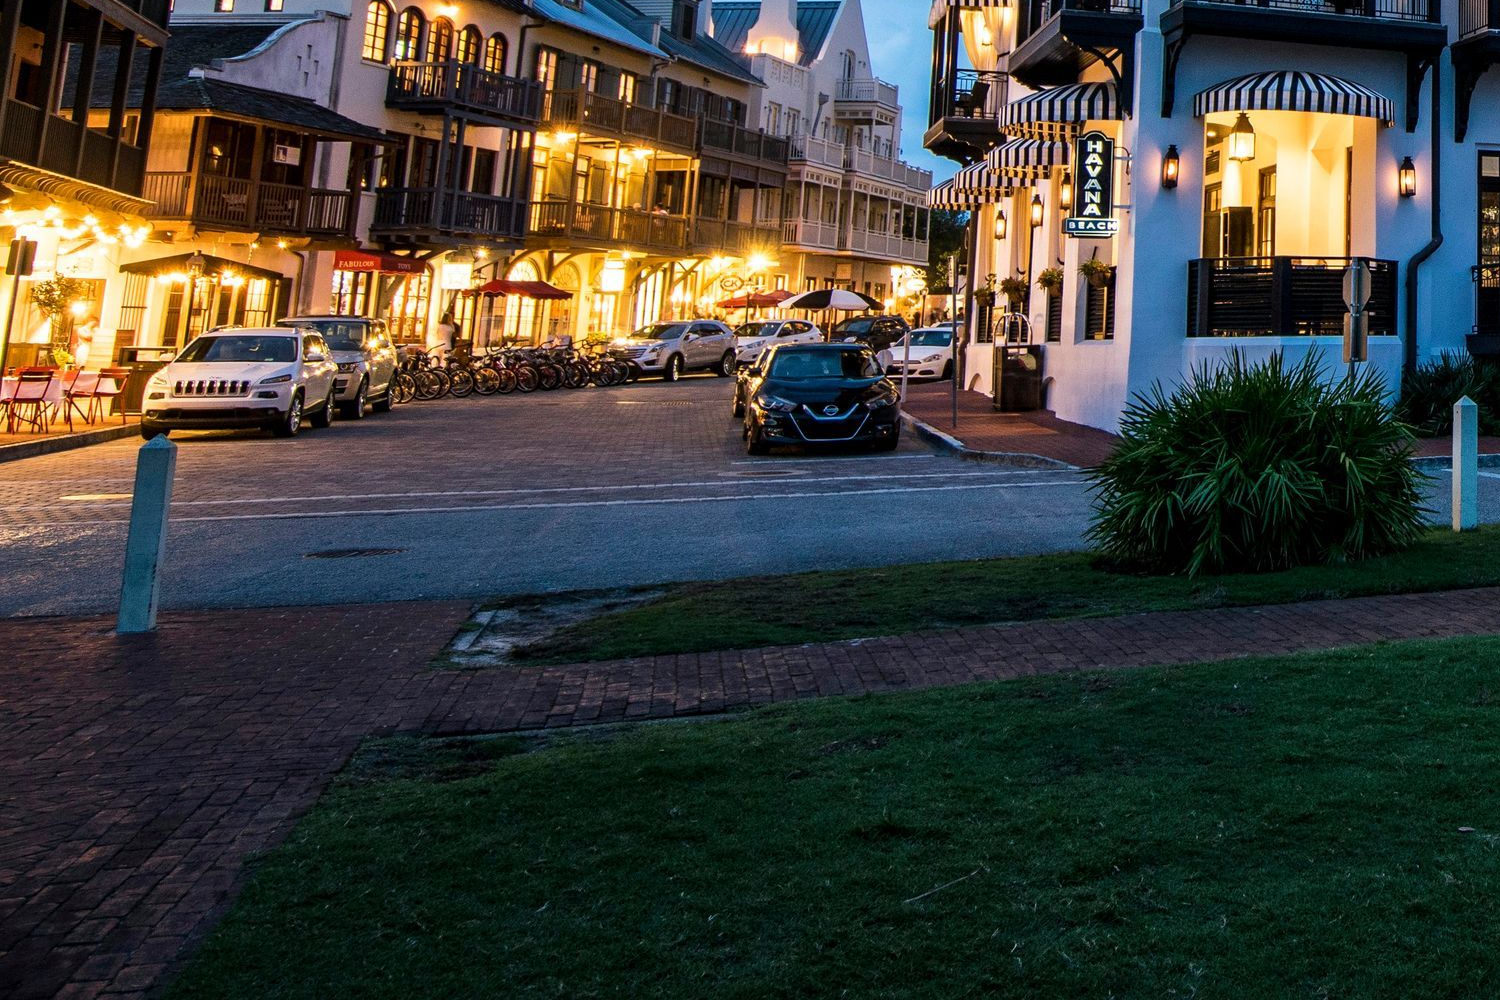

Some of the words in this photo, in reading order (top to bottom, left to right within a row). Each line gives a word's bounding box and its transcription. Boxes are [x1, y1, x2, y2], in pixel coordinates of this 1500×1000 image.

[1083, 140, 1103, 216] HAVANA
[1068, 221, 1118, 231] BEACH
[339, 260, 375, 268] FABULOUS
